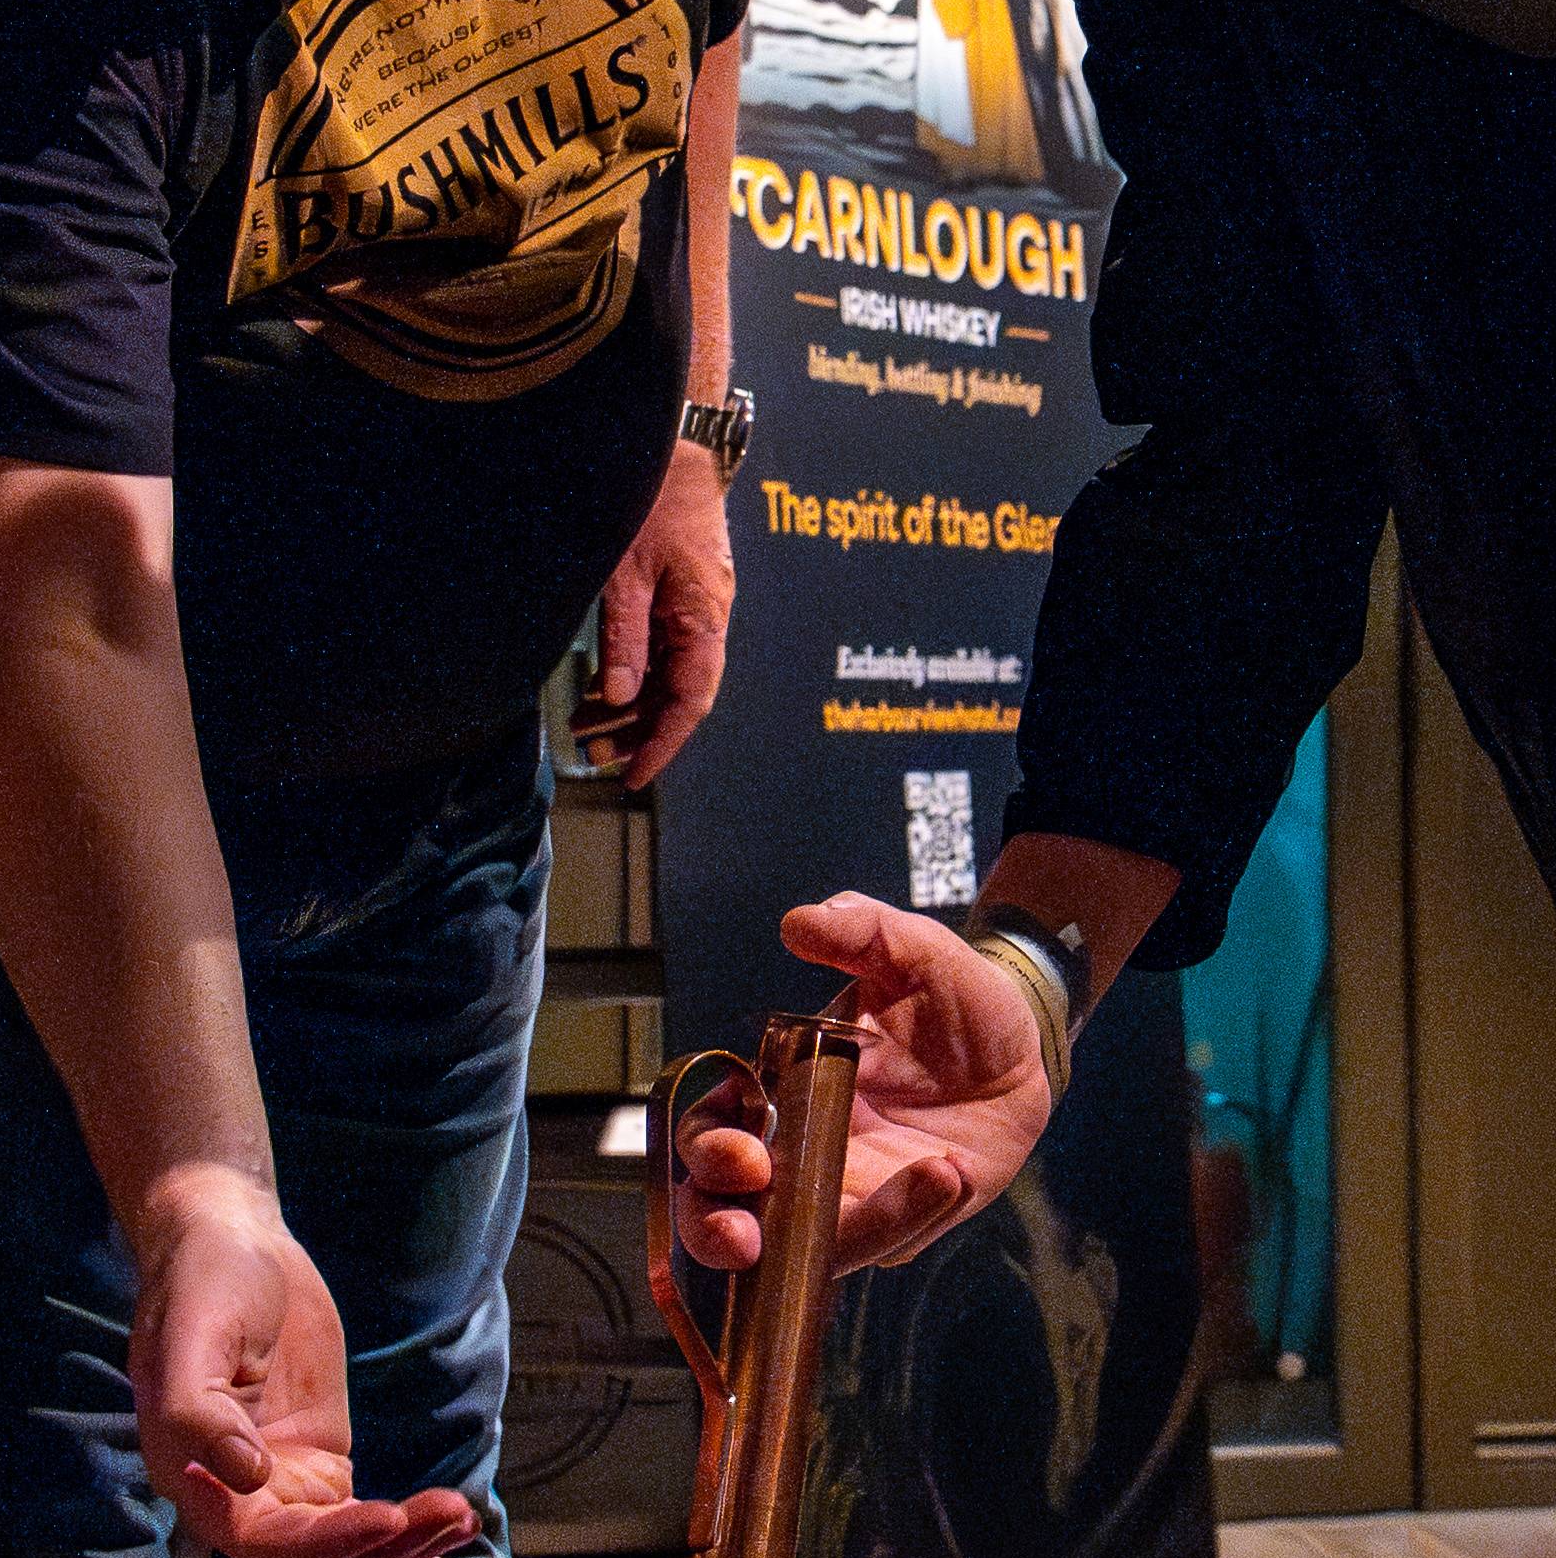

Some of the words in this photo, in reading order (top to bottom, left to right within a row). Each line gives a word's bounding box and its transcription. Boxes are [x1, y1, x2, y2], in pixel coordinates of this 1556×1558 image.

[377, 15, 482, 81] BECAUSE
[282, 40, 650, 265] BUSHMILLS
[734, 156, 1087, 303] CARNLOUGH
[839, 286, 897, 332] IRISH
[898, 295, 1002, 348] WHISKEY
[759, 479, 822, 538] The
[824, 489, 902, 552] spirit
[902, 493, 937, 546] of
[938, 497, 991, 552] the
